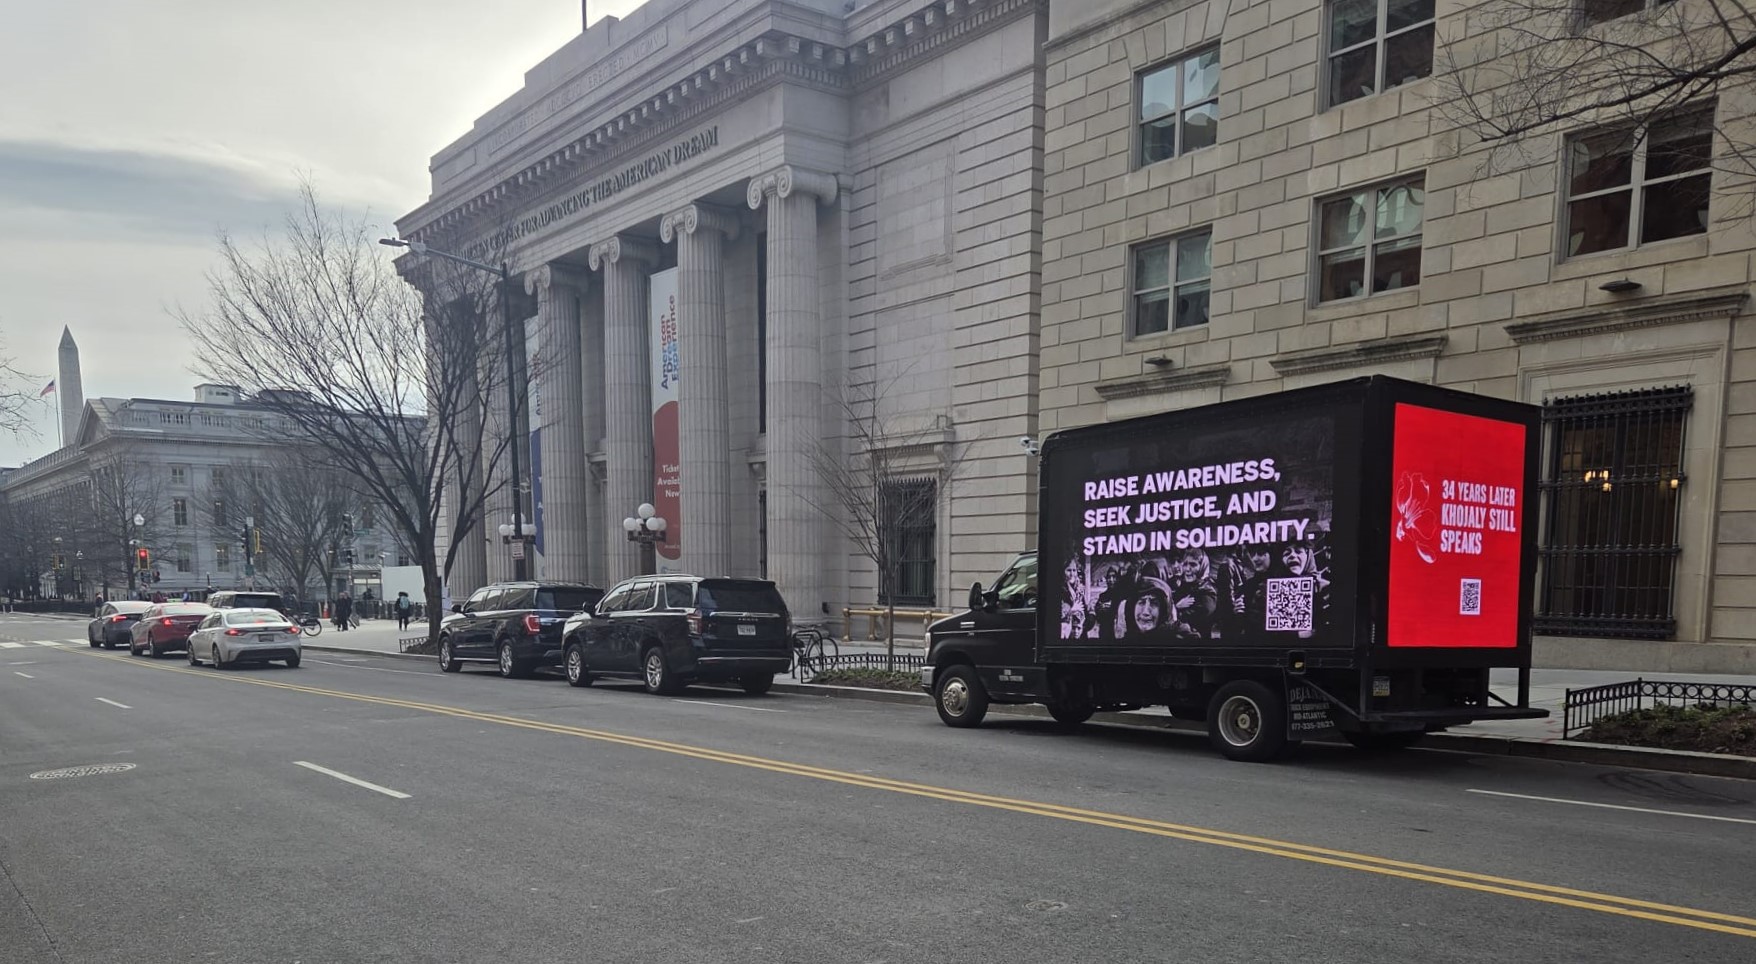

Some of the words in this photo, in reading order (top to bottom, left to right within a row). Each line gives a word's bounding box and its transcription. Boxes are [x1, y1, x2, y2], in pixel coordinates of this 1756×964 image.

[538, 189, 590, 228] ADVANCING
[589, 180, 613, 205] THE
[612, 148, 672, 193] AMERICAN
[673, 125, 719, 163] DREAM
[661, 314, 669, 390] American
[669, 295, 680, 382] Experience
[1084, 476, 1139, 500] RAISE
[1142, 458, 1281, 494] AWARENESS,
[1442, 479, 1455, 500] 34
[1458, 481, 1487, 504] YEARS
[1489, 485, 1516, 507] LATER
[1083, 506, 1131, 528] SEEK
[1135, 496, 1222, 525] JUSTICE,
[1226, 490, 1276, 515] AND
[1441, 503, 1487, 529] KHOJALY
[1489, 508, 1516, 533] STILL
[1083, 532, 1146, 556] STAND
[1150, 530, 1171, 551] IN
[1176, 518, 1315, 549] SOLIDARITY.
[1440, 529, 1482, 555] SPEAKS
